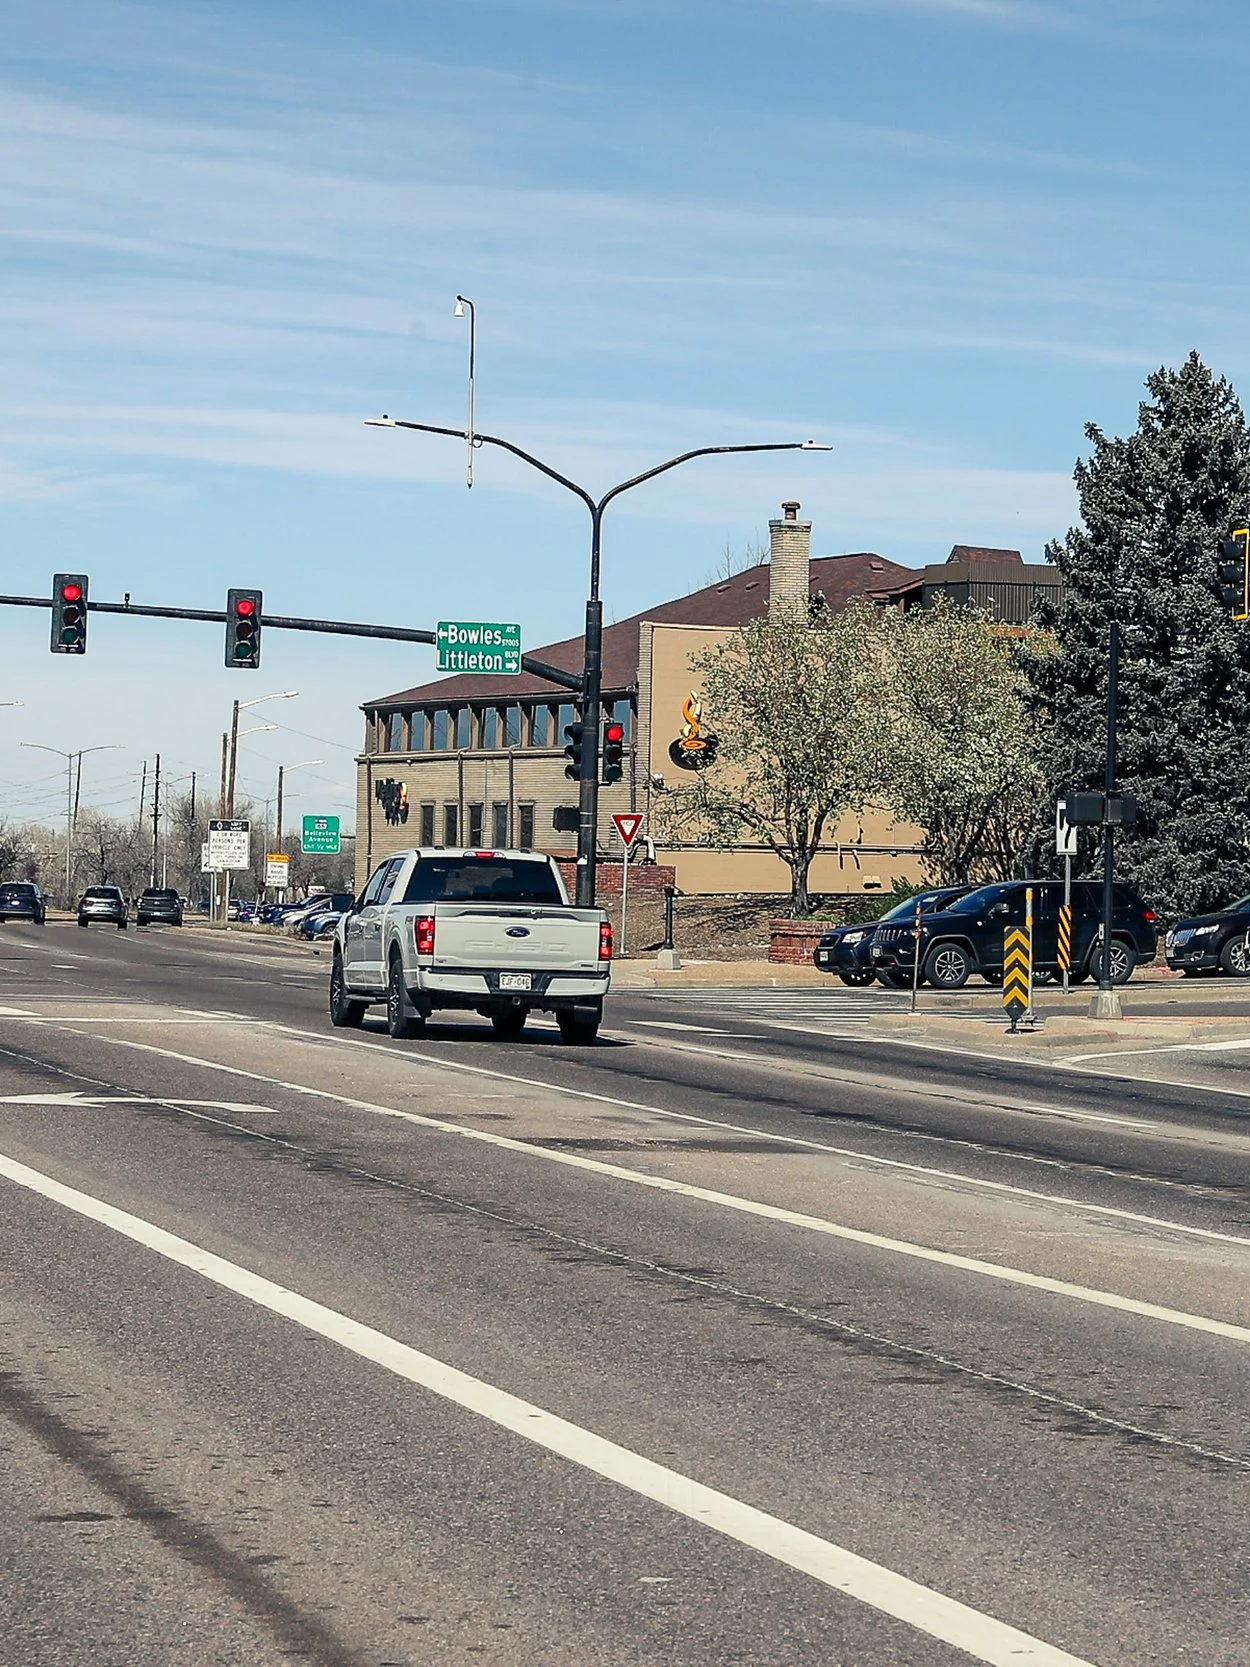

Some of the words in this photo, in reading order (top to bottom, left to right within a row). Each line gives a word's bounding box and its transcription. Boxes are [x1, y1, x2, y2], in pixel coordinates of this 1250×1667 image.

[447, 624, 502, 646] Bowles
[505, 626, 516, 634] AVE
[436, 649, 503, 671] Littleton
[504, 650, 519, 659] BLVD
